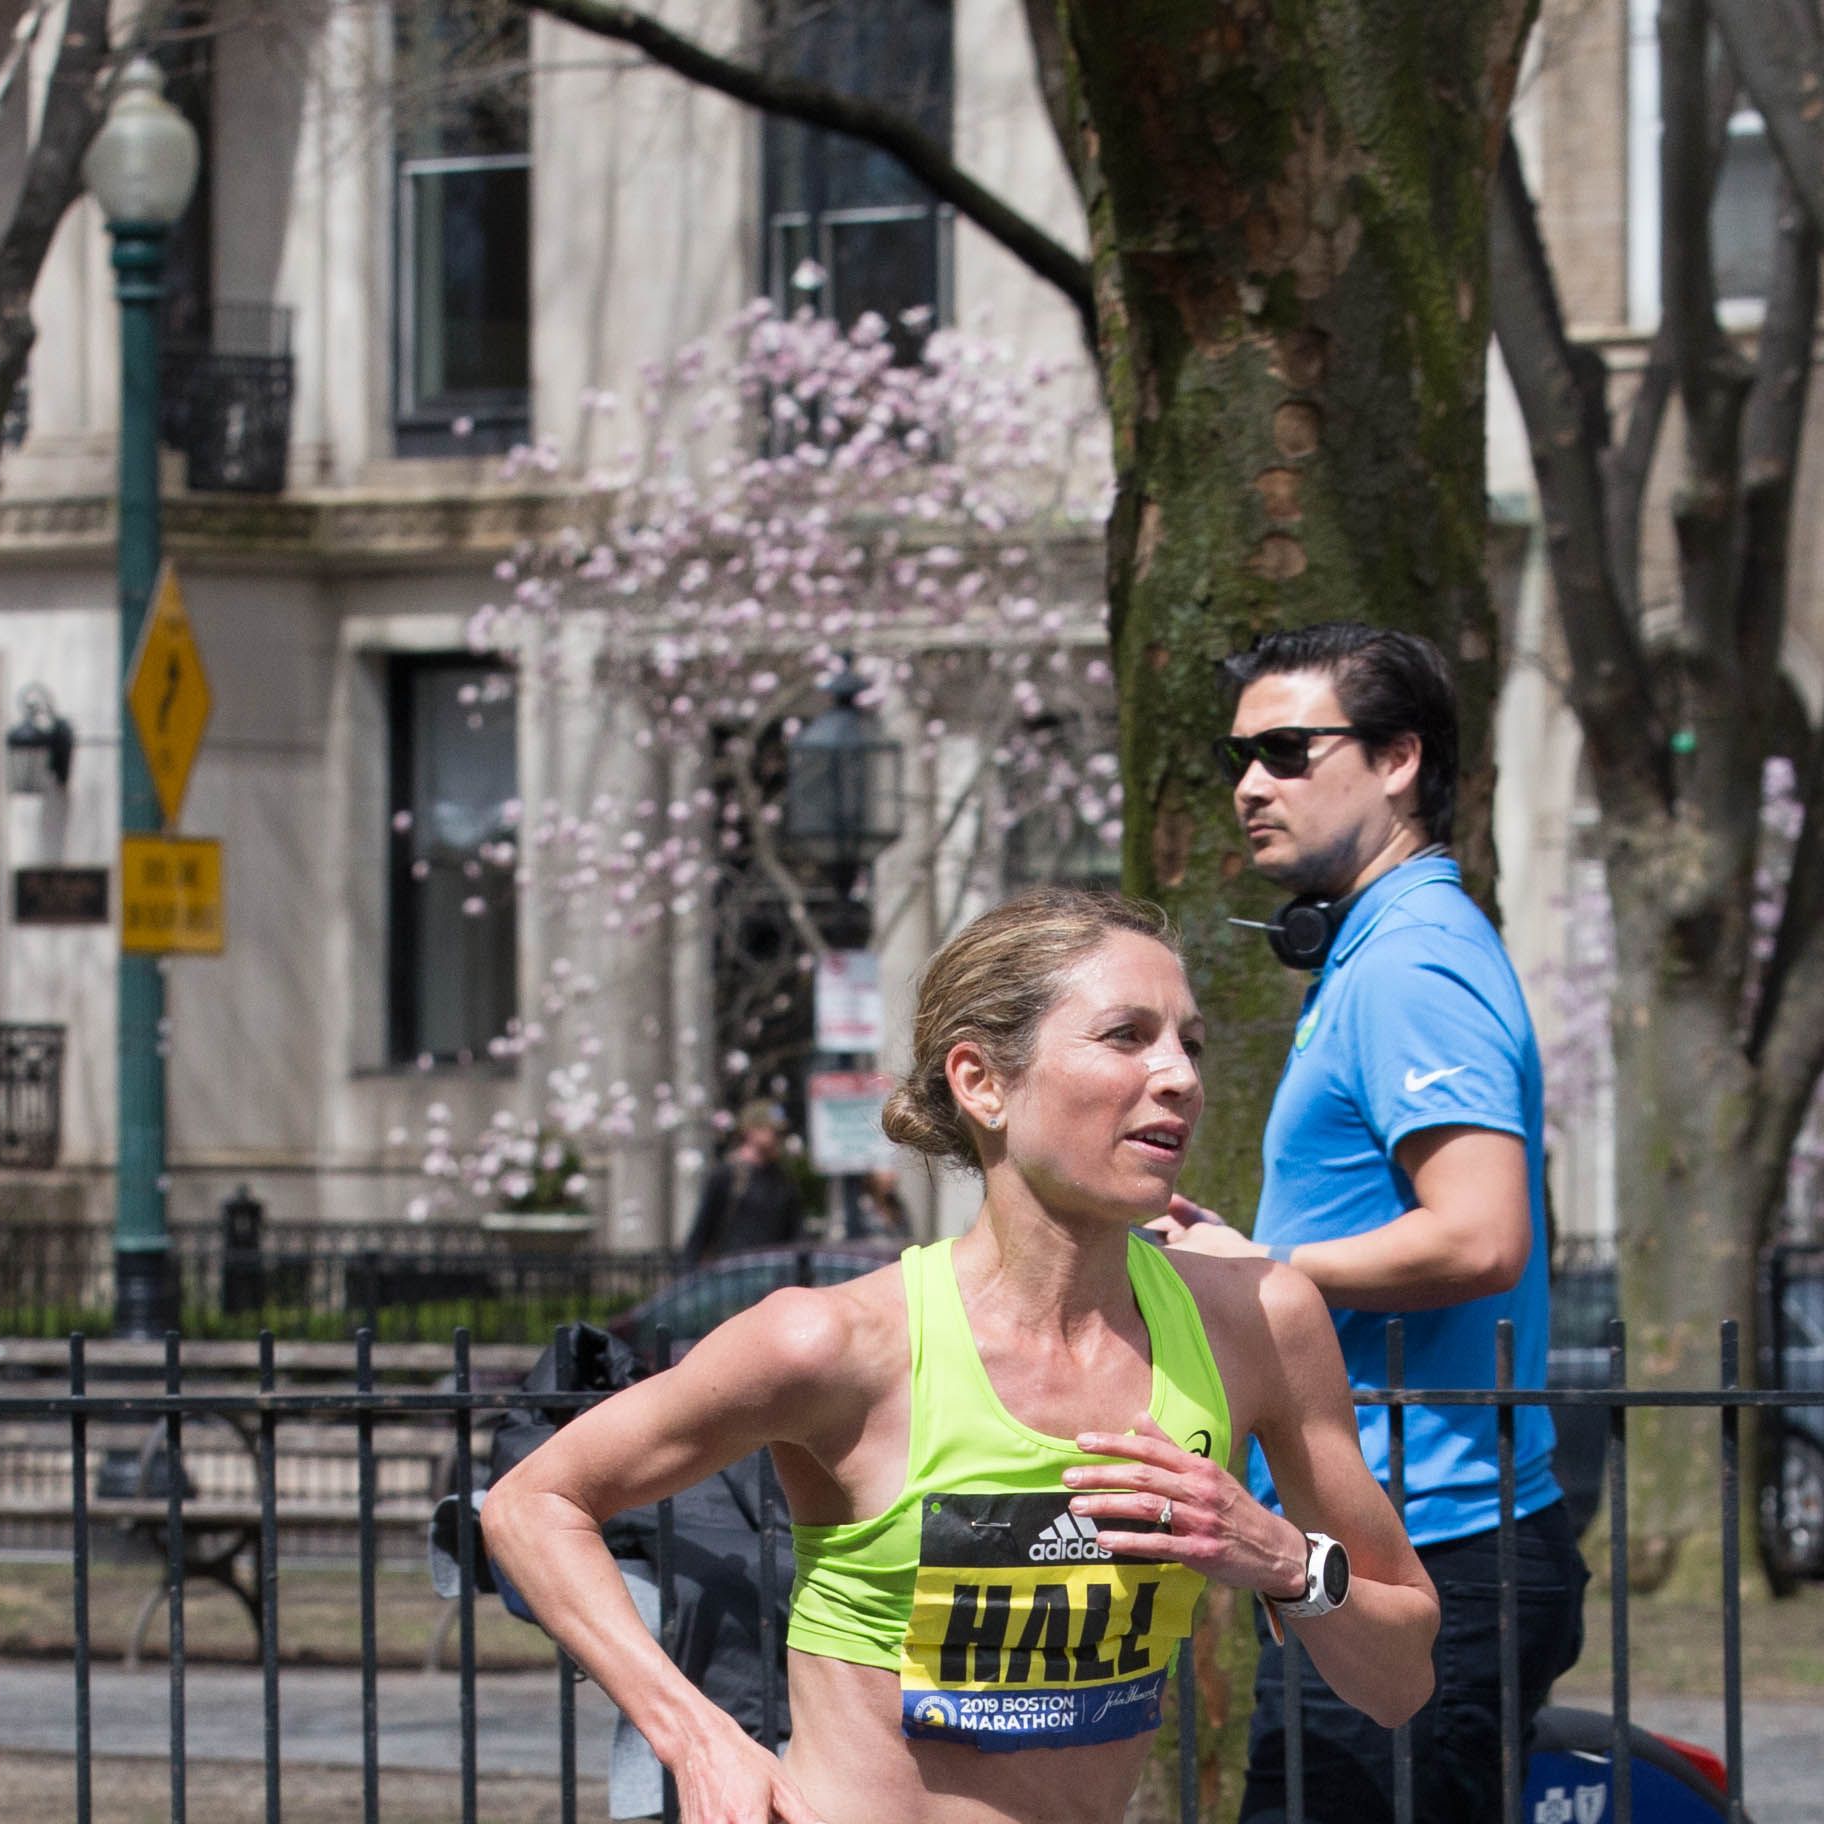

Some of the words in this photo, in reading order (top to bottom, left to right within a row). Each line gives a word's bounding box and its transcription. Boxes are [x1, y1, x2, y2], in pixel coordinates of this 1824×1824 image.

[1028, 1538, 1113, 1562] adidas
[939, 1582, 1161, 1683] HALL
[959, 1698, 999, 1714] 2019
[1002, 1695, 1075, 1713] BOSTON
[960, 1712, 1077, 1731] MARATHON
